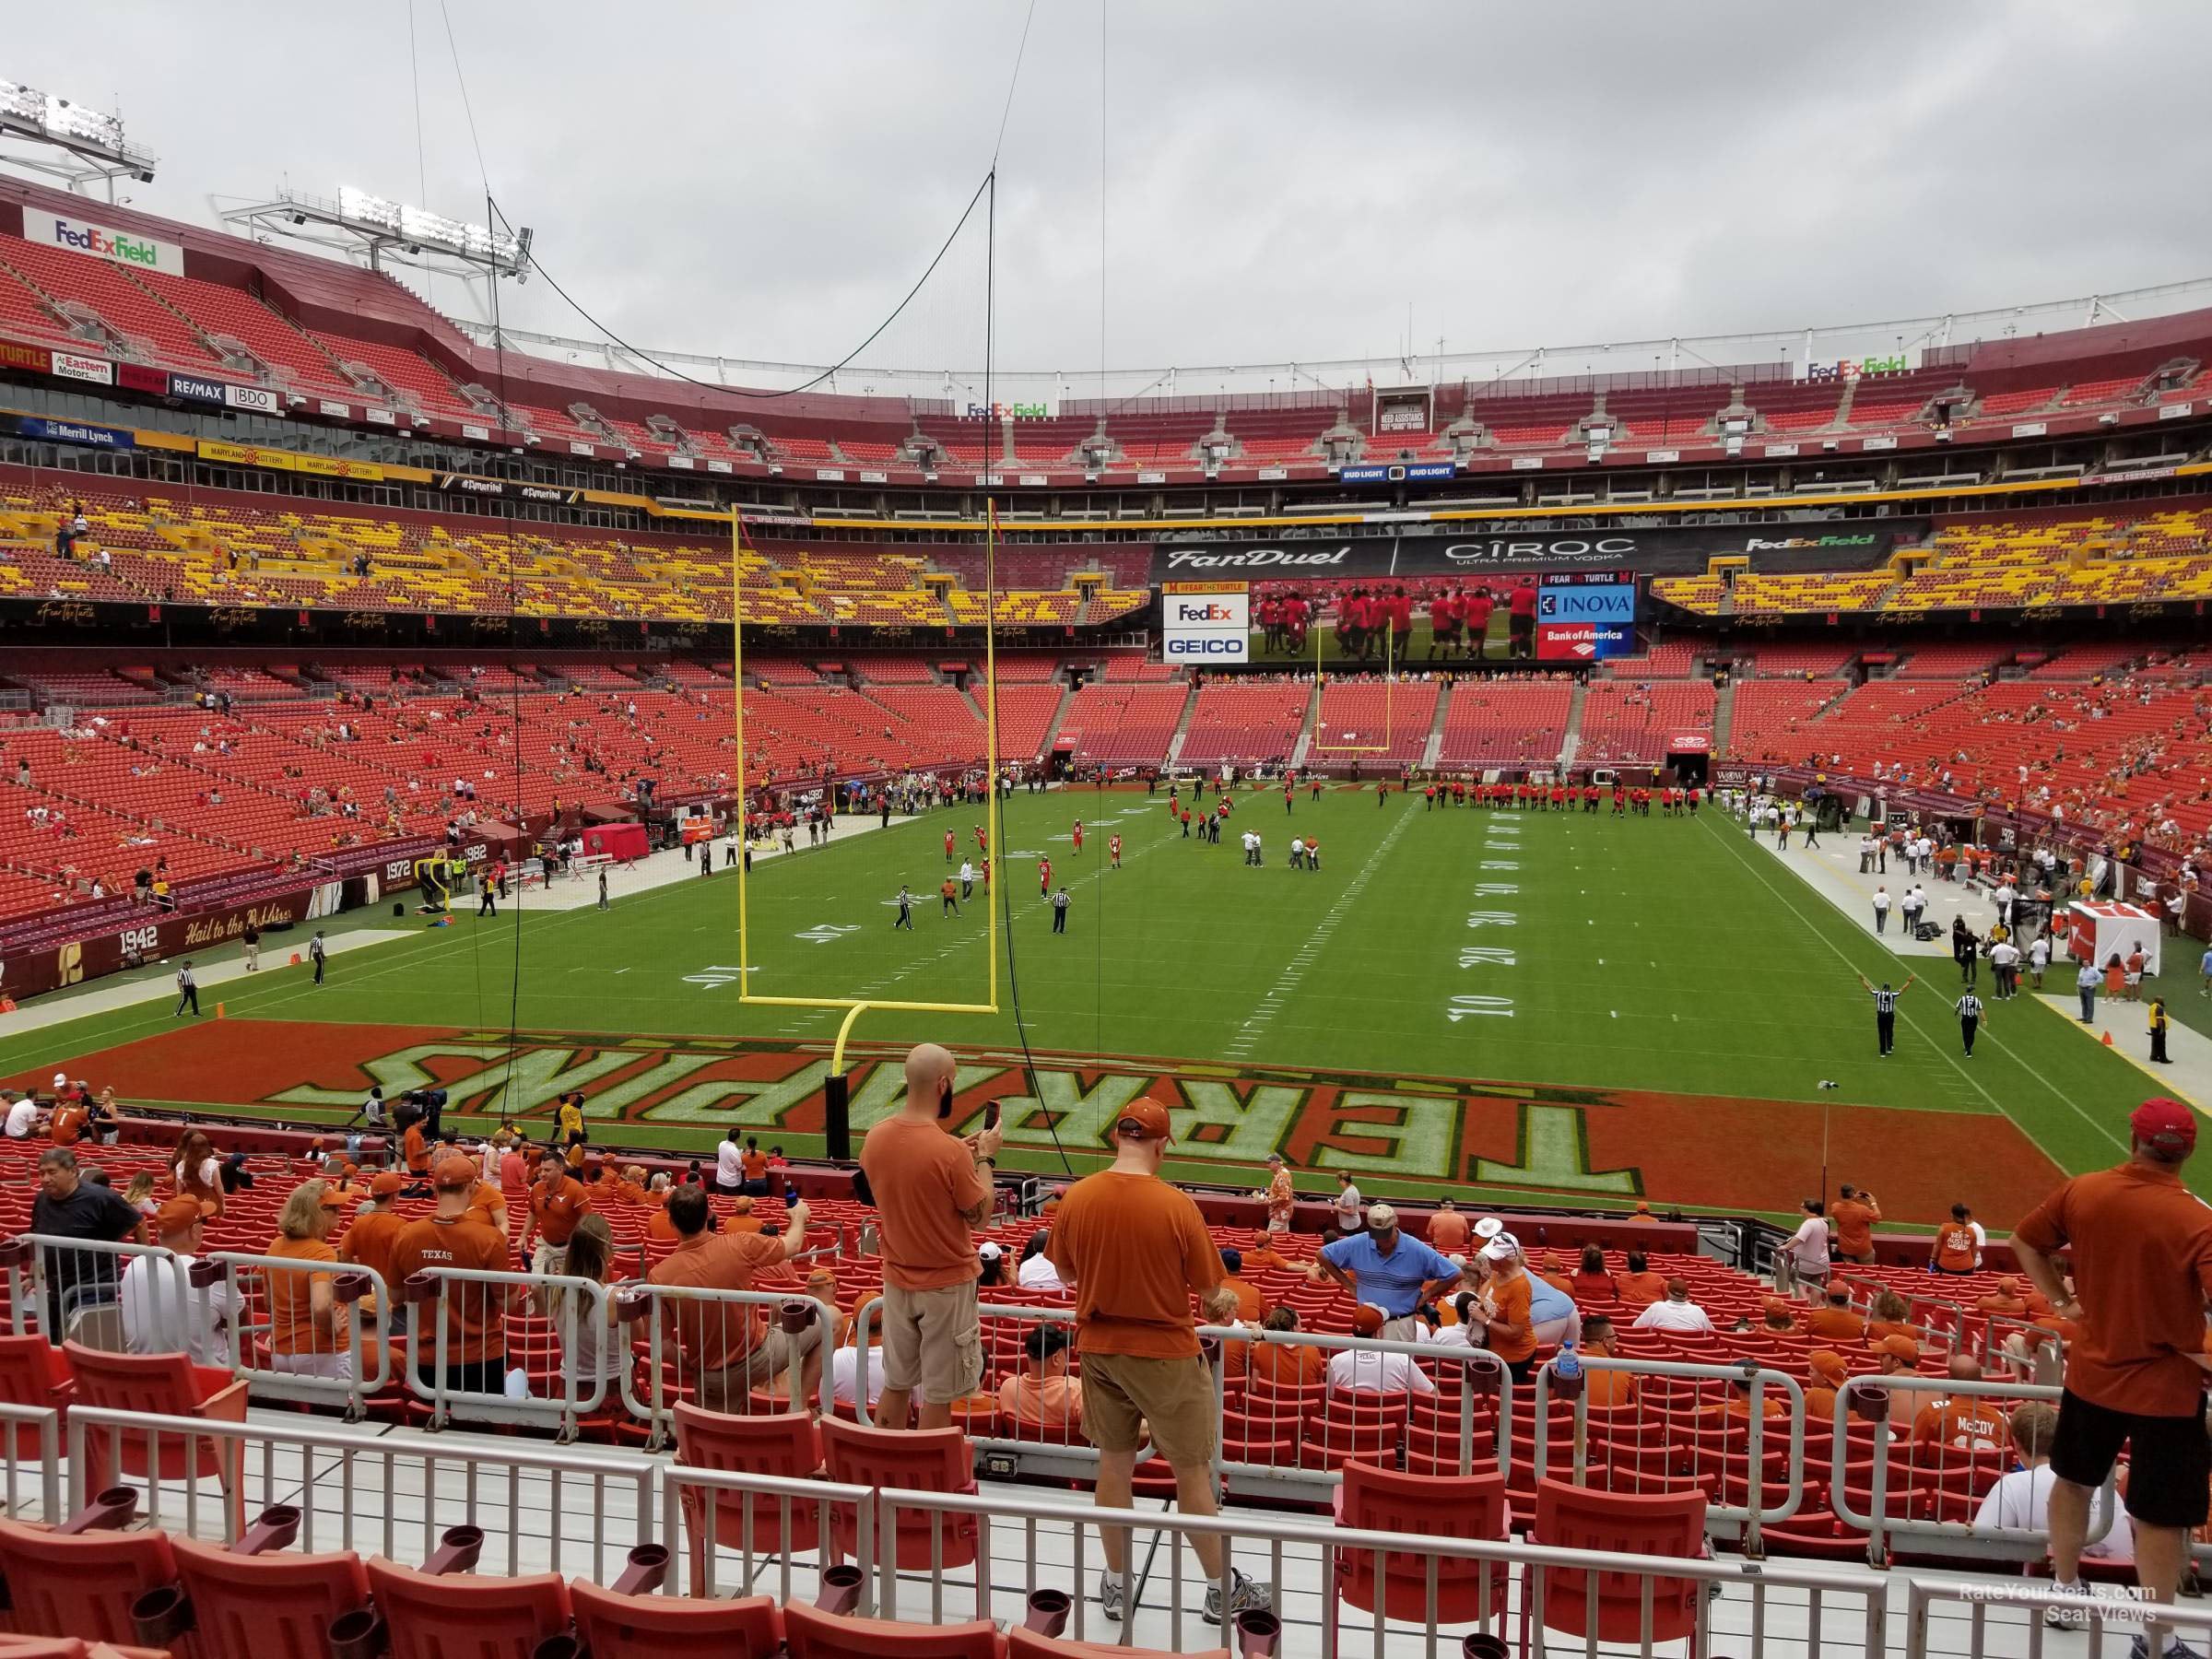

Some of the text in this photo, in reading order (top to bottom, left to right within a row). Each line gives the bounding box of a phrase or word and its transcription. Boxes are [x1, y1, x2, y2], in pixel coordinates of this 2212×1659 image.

[55, 220, 157, 265] FedExField
[0, 344, 48, 368] TURTLE
[65, 357, 108, 373] Eastern
[1808, 355, 1906, 379] FedExField
[174, 379, 222, 400] RE/MAX
[239, 388, 267, 405] BDO
[968, 403, 1047, 417] FedExField
[59, 425, 87, 439] Merrill
[89, 429, 113, 443] Lynch
[211, 447, 283, 464] MARYLAND LOTTERY
[307, 461, 336, 471] MARYLAND
[1746, 535, 1875, 551] FedExField
[1168, 547, 1350, 568] FanDuel
[1574, 553, 1623, 561] VODKA
[1179, 604, 1231, 620] FedEx
[1563, 596, 1630, 613] INOVA
[1547, 629, 1622, 641] Bank of America
[1169, 640, 1242, 653] GEICO
[386, 860, 410, 879] 1972
[185, 917, 214, 945] Hail
[214, 918, 224, 937] to
[227, 913, 243, 935] the
[120, 925, 158, 954] 1942
[1458, 947, 1515, 966] 20
[1447, 995, 1513, 1018] 10
[421, 1250, 453, 1261] TEXAS
[1958, 1417, 1994, 1435] McCOY
